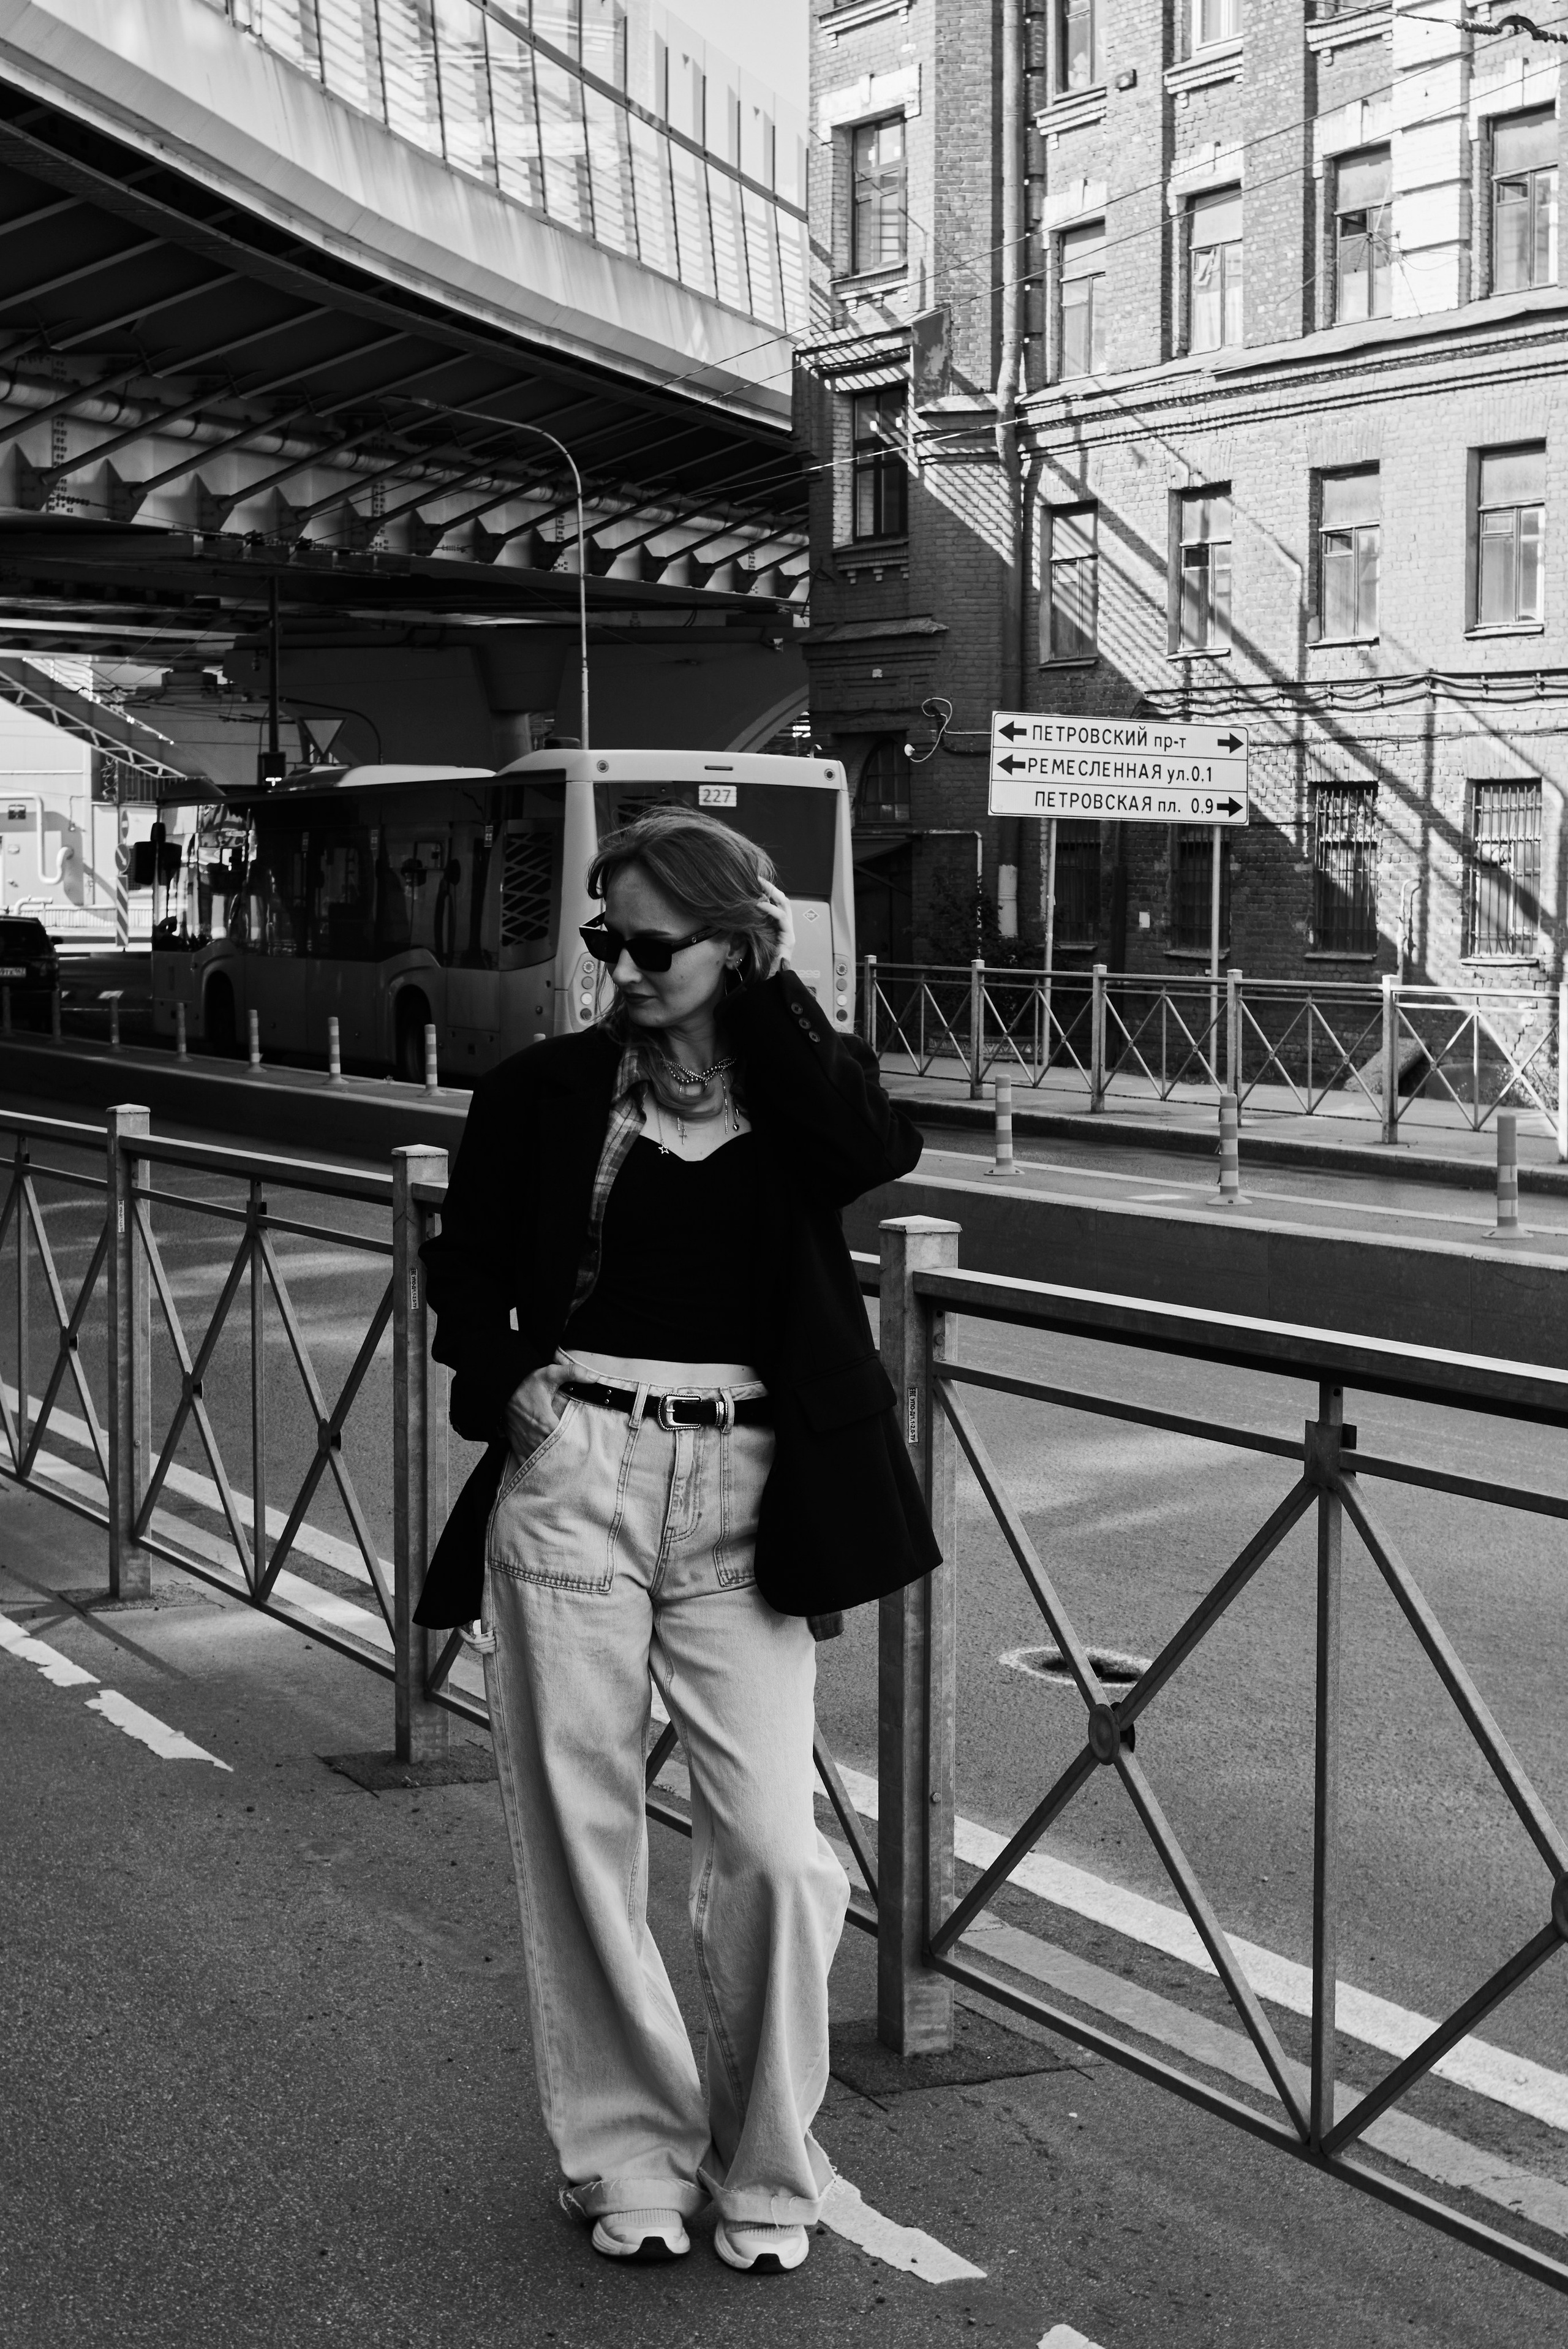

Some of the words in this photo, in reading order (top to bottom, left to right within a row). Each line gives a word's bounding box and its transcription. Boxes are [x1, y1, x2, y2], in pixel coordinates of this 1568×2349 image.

[1033, 725, 1147, 746] ПЕТРОВСКИЙ
[1155, 736, 1186, 752] пр-т
[1028, 757, 1161, 779] РЕМЕСЛЕННАЯ
[703, 789, 731, 803] 227
[1035, 791, 1152, 811] ПЕТРОВСКАЯ
[1158, 801, 1181, 812] пл.
[794, 970, 820, 978] 299
